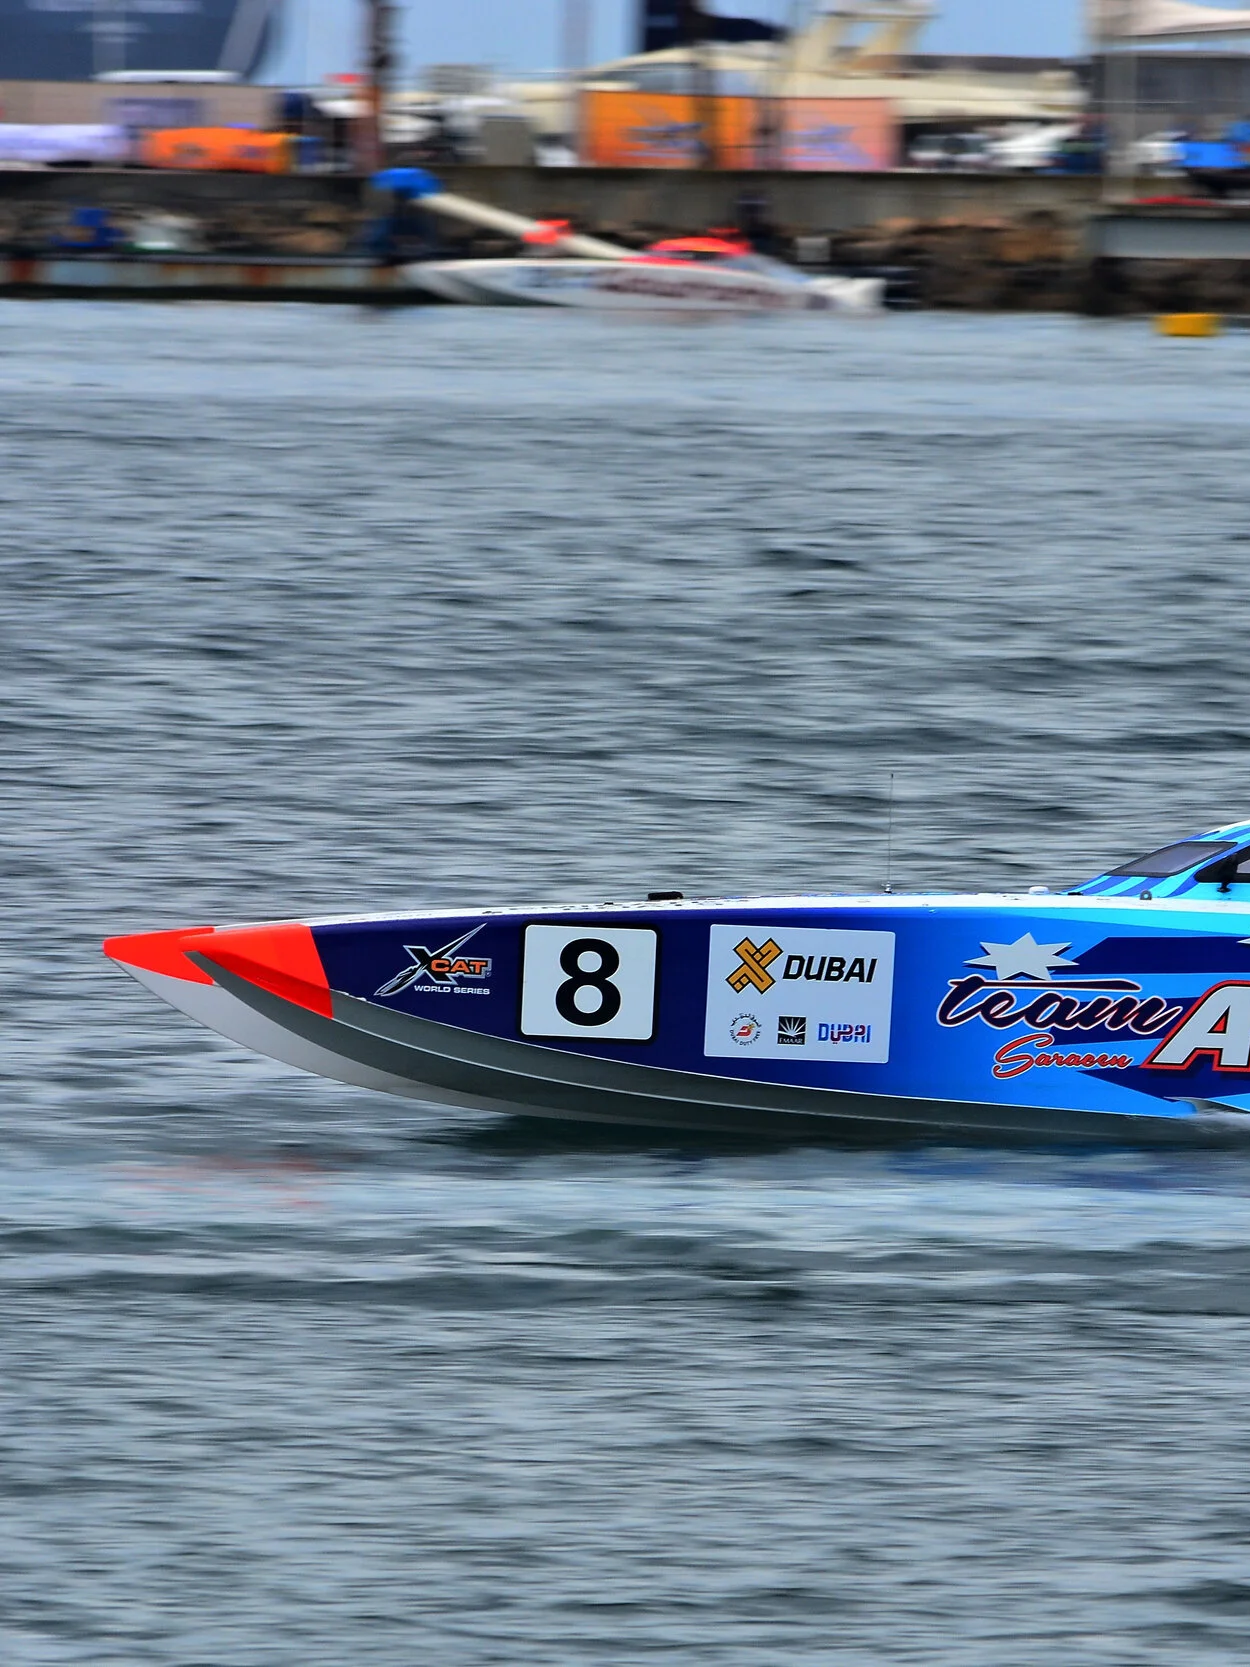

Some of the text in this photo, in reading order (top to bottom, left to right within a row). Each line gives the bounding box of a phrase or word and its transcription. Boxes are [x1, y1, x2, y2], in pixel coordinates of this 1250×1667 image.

[414, 985, 490, 995] WORLD SERIES
[555, 938, 621, 1026] 8
[783, 955, 877, 983] DUBAI
[936, 974, 1183, 1034] team
[992, 1033, 1133, 1079] Saracen
